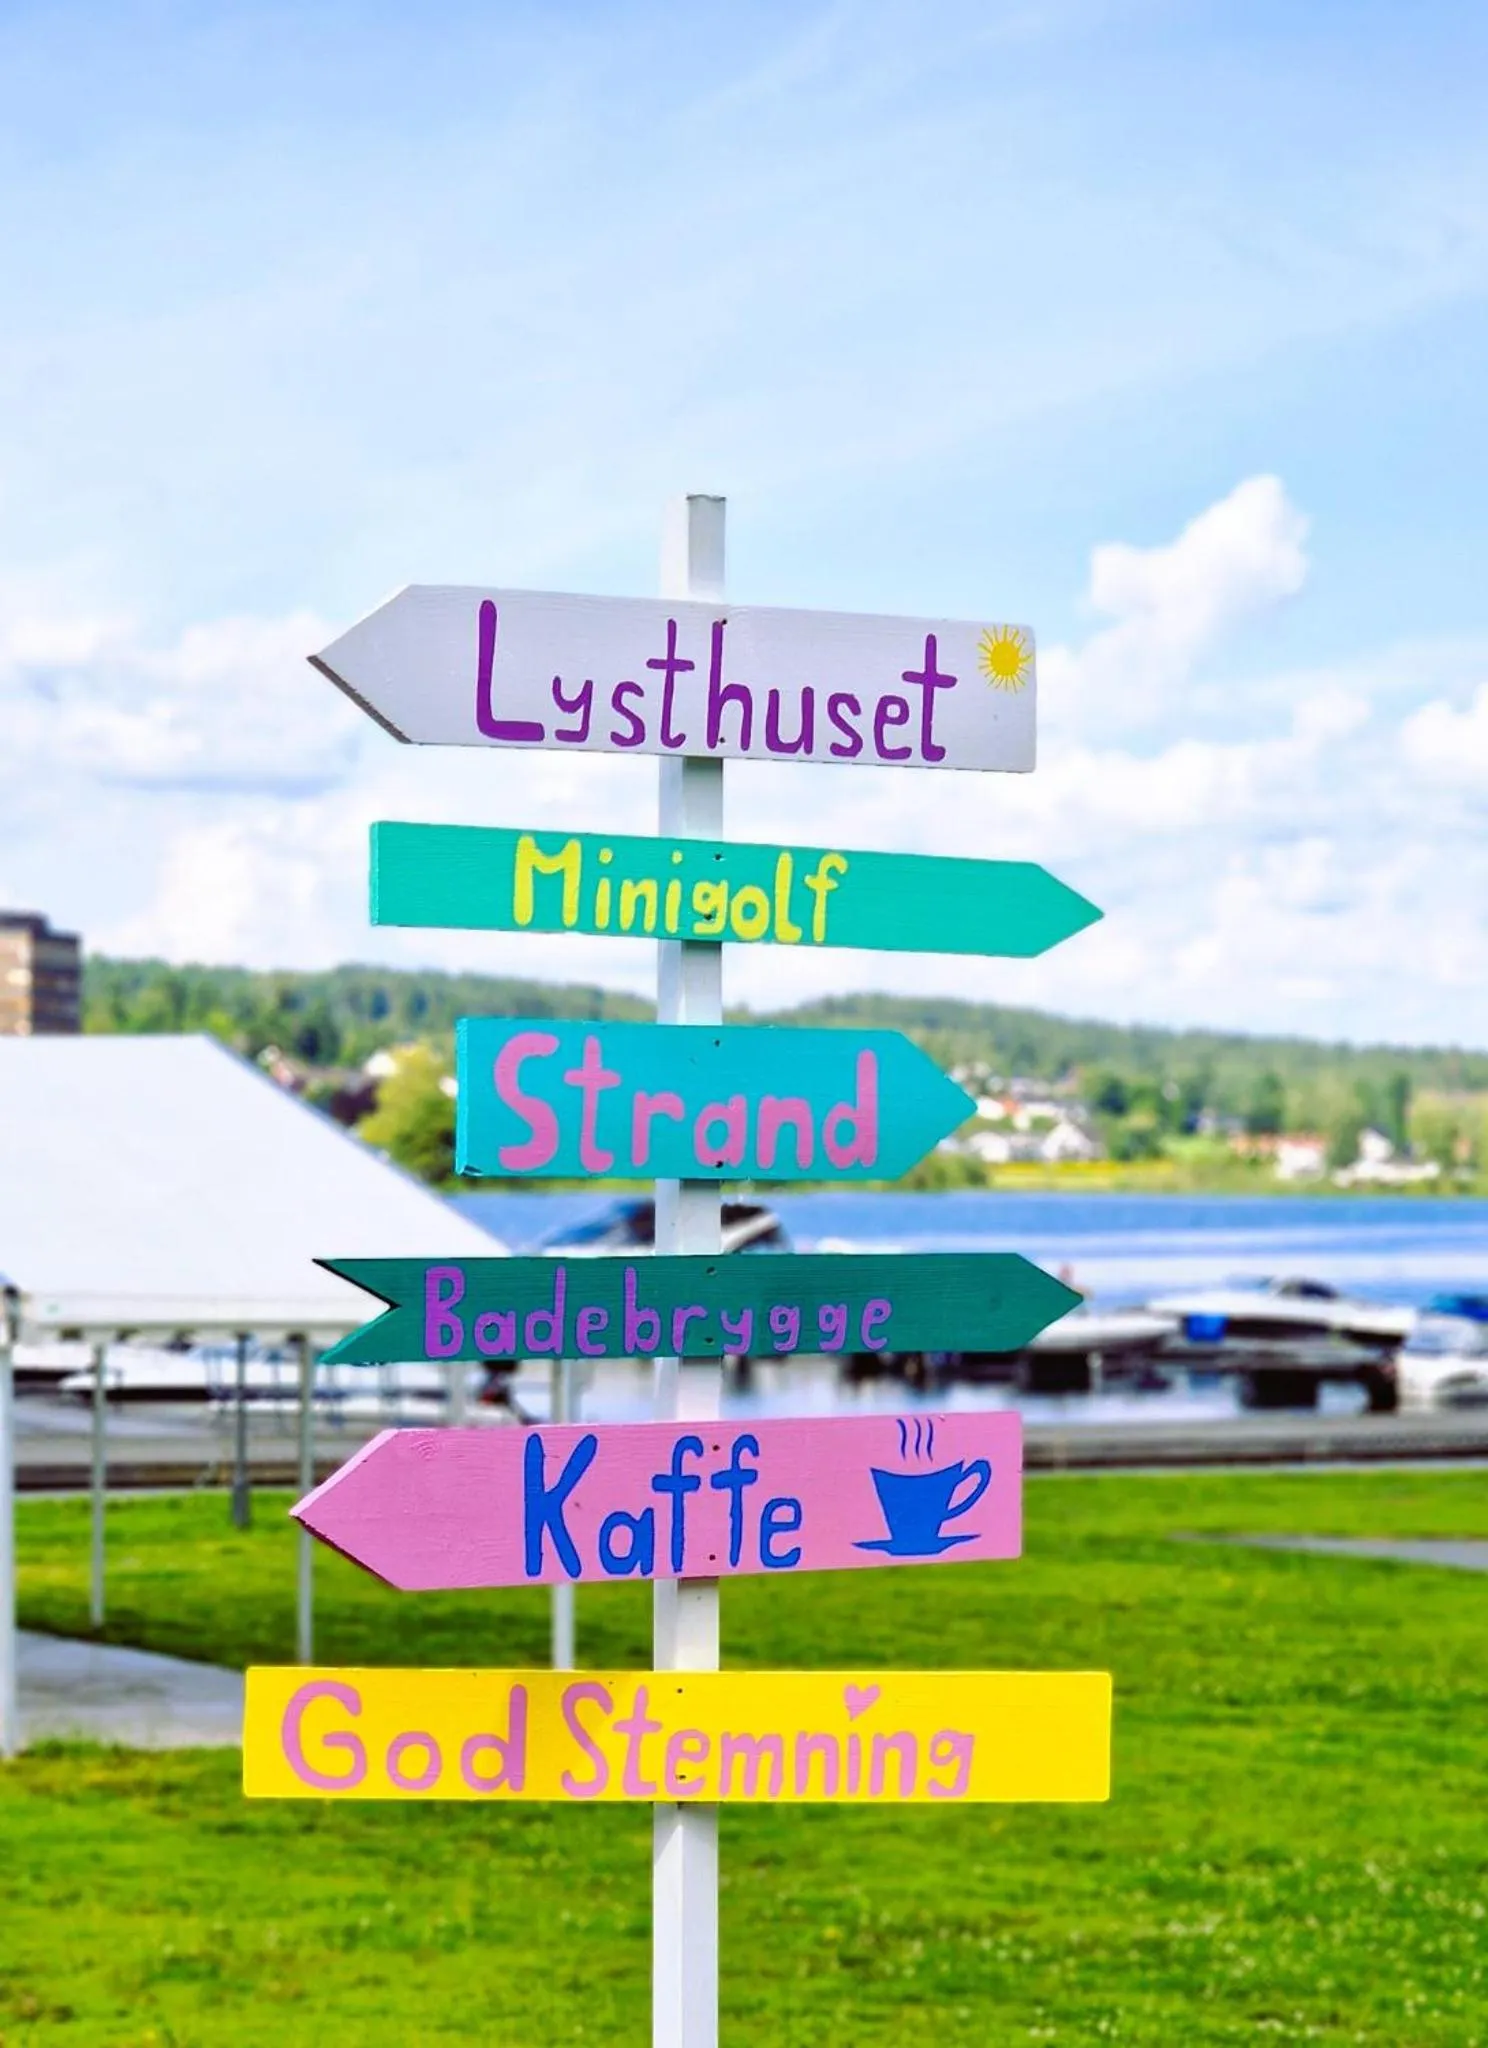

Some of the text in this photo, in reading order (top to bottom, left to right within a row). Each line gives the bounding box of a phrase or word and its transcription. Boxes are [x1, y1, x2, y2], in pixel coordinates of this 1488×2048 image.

[476, 599, 958, 762] Lysthuset
[513, 834, 848, 943] Minigolf
[493, 1032, 879, 1173] Strand
[423, 1265, 893, 1358] Badebrygge
[522, 1433, 803, 1578] Kaffe
[281, 1680, 976, 1798] God Stemning
